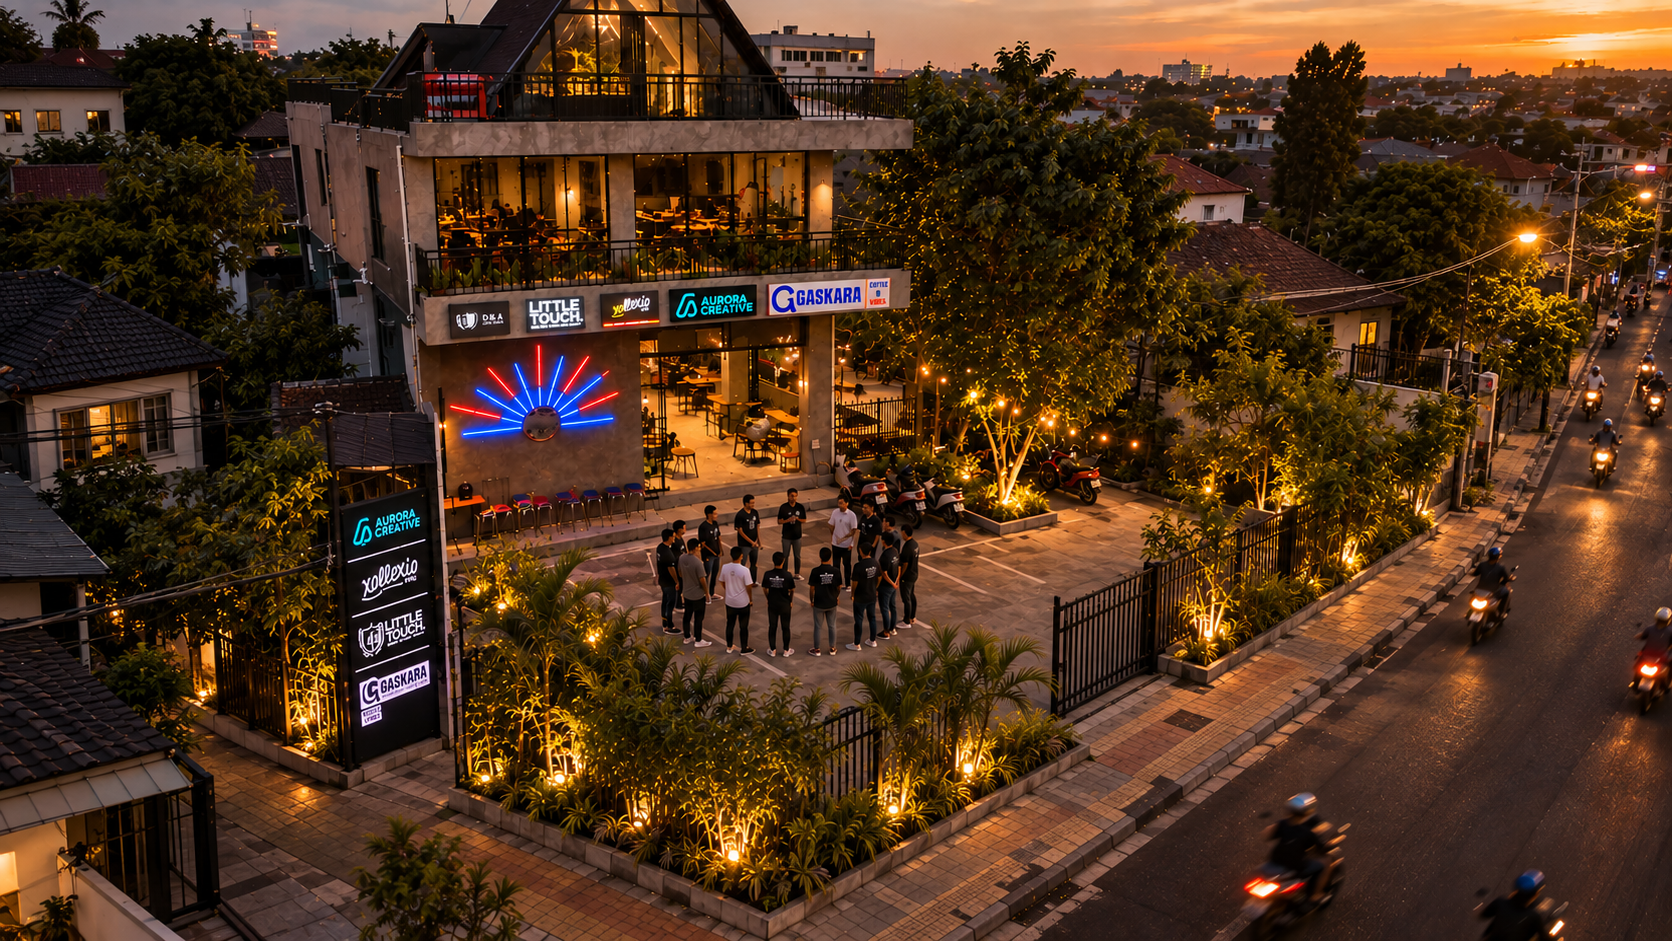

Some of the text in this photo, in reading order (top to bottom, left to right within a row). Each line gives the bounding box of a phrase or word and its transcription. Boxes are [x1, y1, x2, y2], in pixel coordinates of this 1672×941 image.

[529, 298, 580, 313] LITTLE
[701, 294, 747, 306] AURORA
[796, 286, 862, 306] GASKARA
[529, 311, 584, 325] TOUCH.
[700, 302, 753, 315] CREATIVE
[374, 517, 421, 538] CREATIVE
[375, 508, 416, 528] AURORA
[384, 609, 423, 631] LITTLE
[385, 620, 426, 642] TOUCH.
[380, 665, 427, 694] GASKARA
